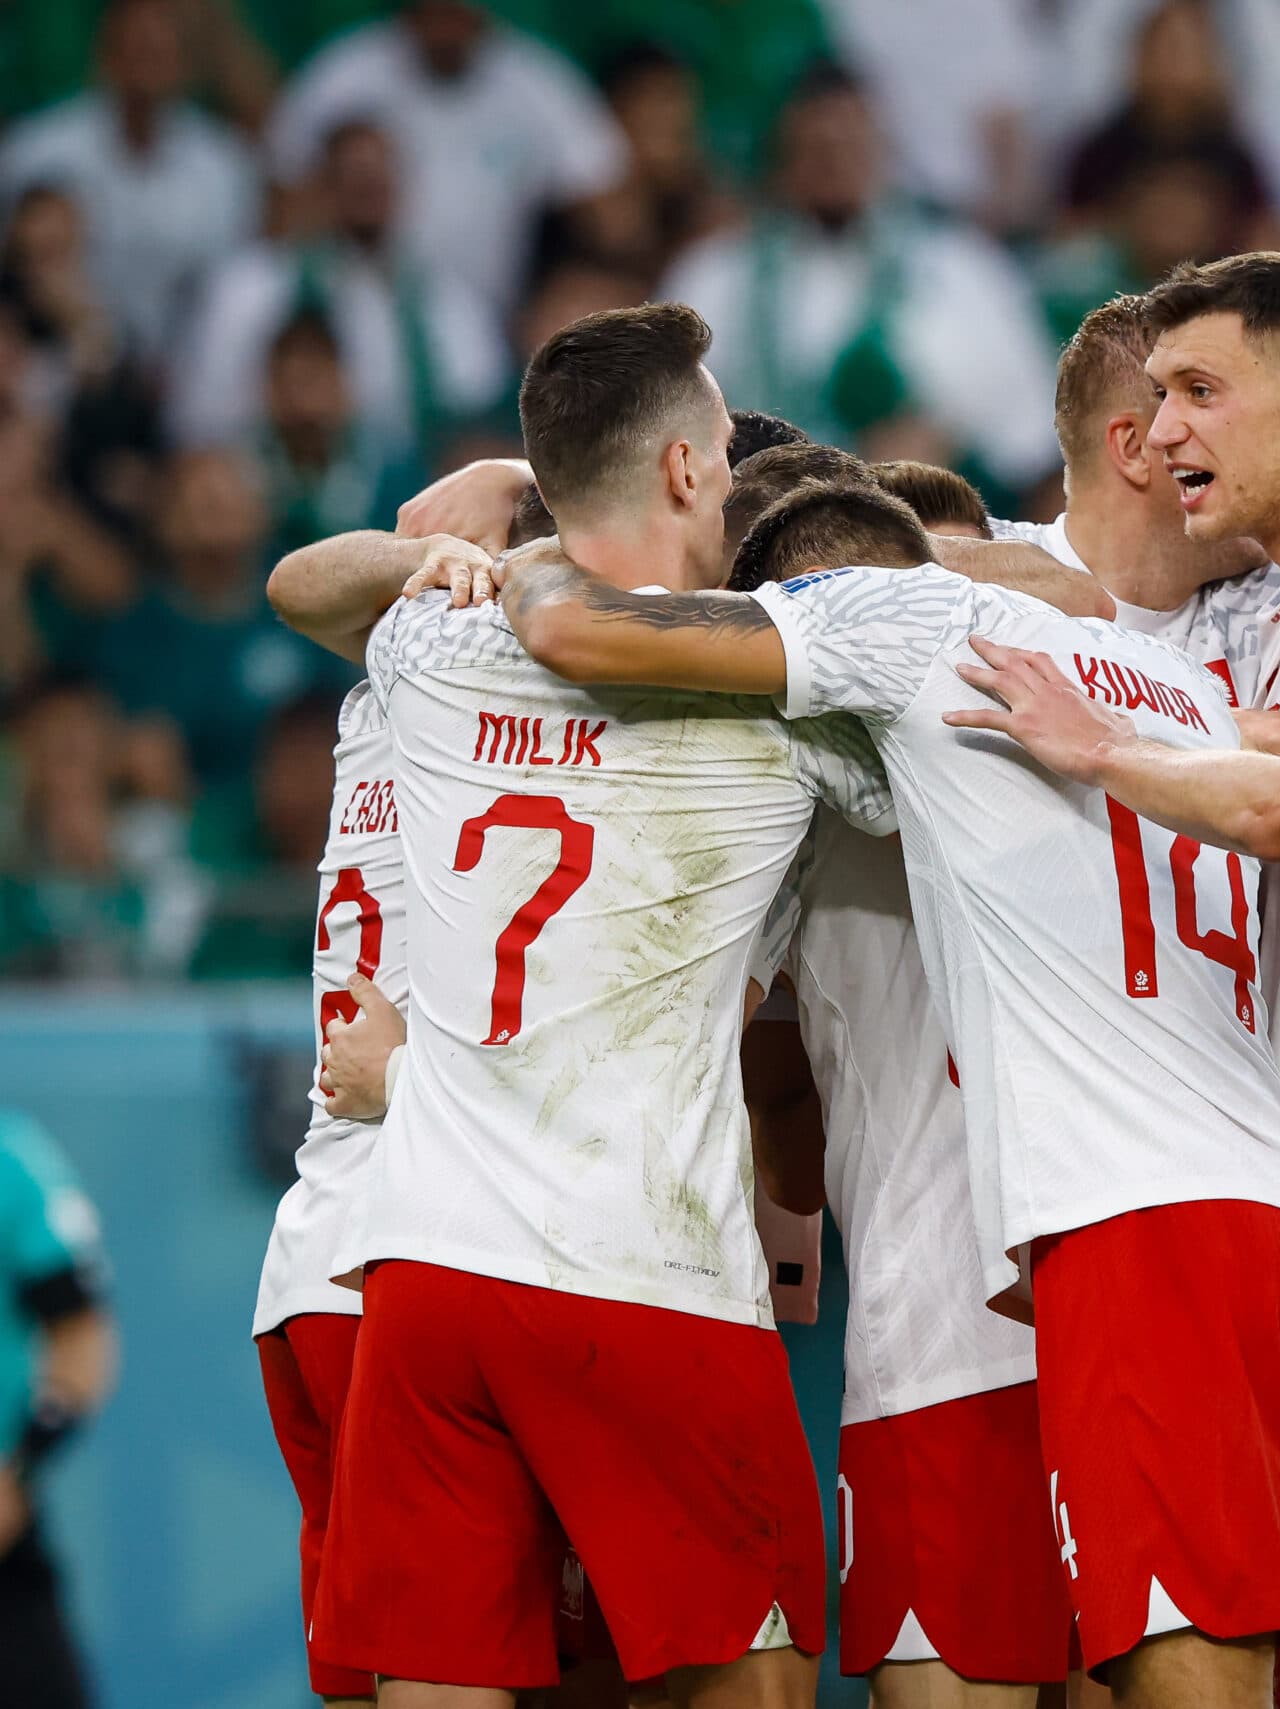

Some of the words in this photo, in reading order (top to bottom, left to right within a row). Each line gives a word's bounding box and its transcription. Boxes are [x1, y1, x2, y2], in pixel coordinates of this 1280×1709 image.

[472, 711, 608, 766] MILIK
[1073, 653, 1212, 735] KIWIOR
[317, 867, 383, 1098] 2
[452, 794, 595, 1046] 7
[1105, 788, 1256, 1035] 14
